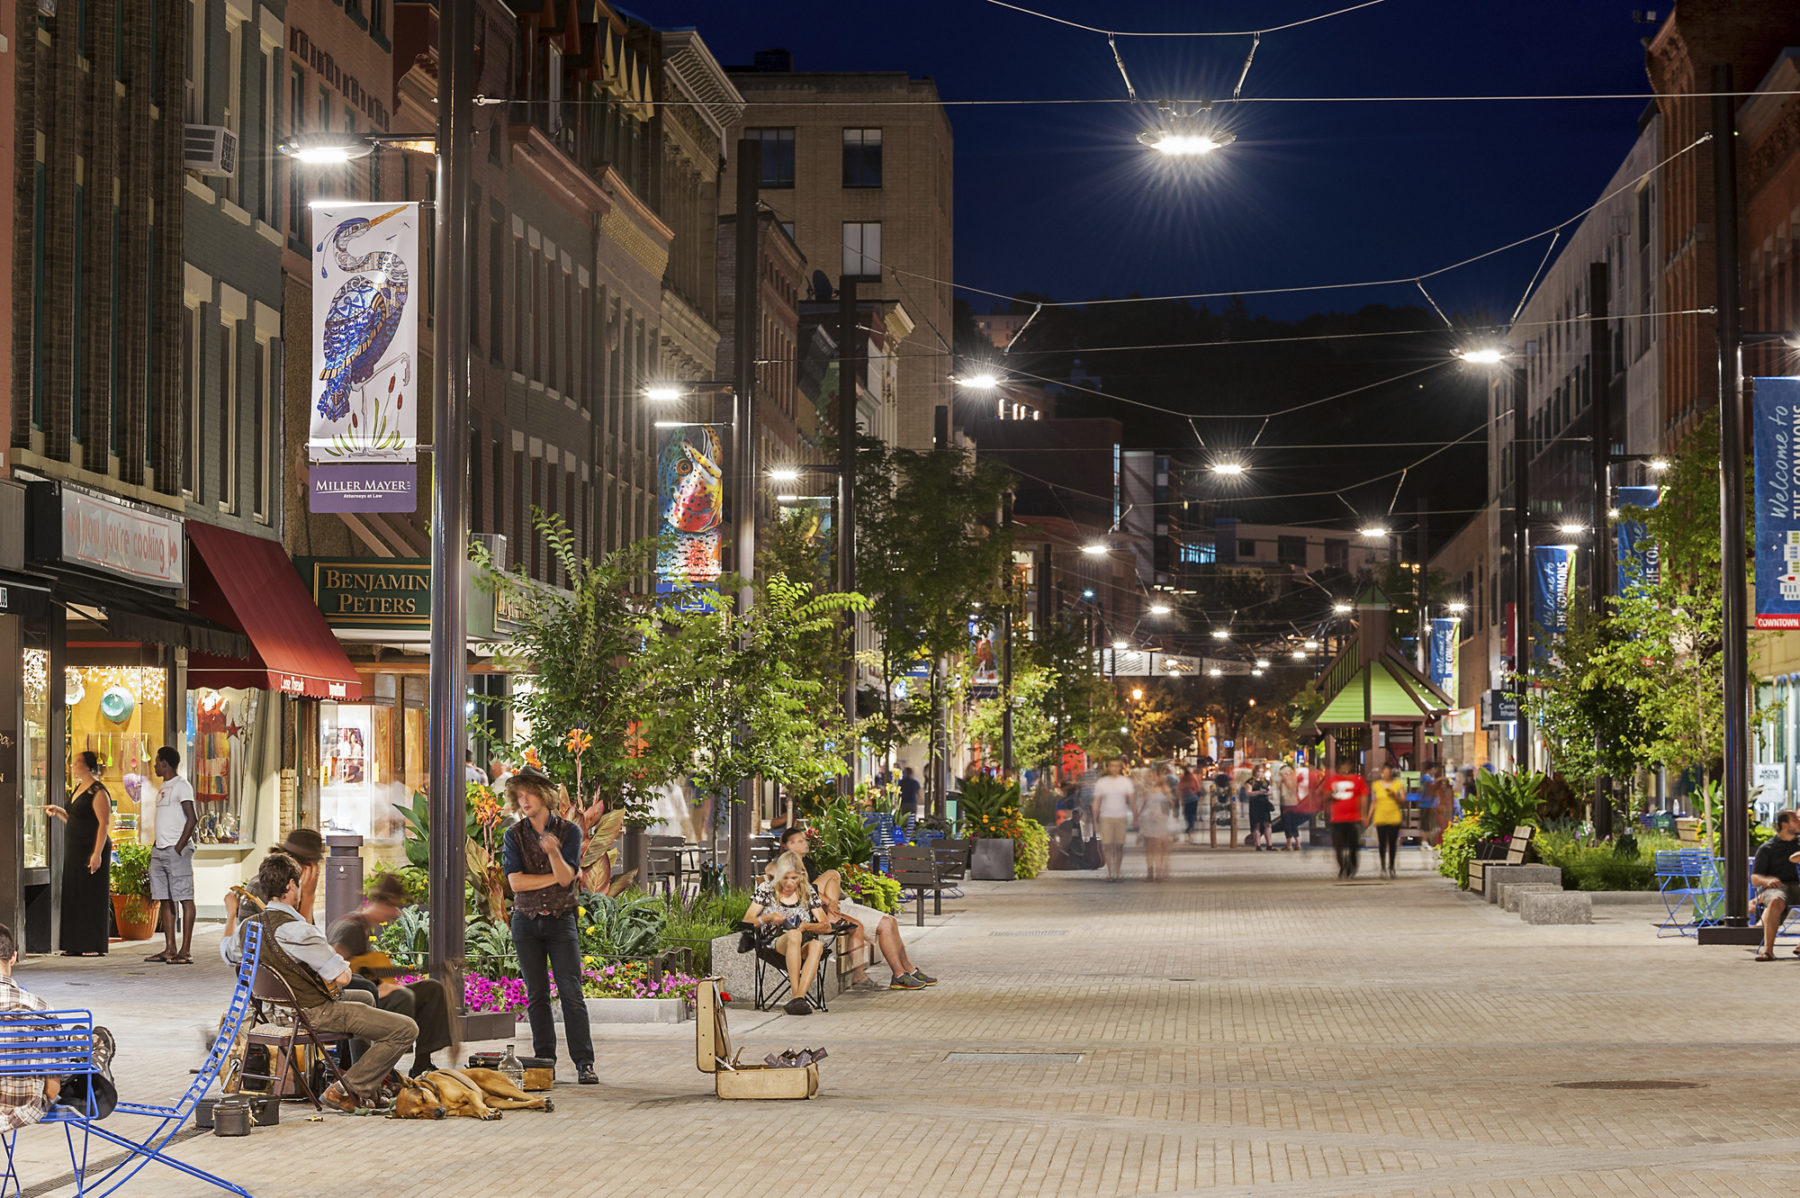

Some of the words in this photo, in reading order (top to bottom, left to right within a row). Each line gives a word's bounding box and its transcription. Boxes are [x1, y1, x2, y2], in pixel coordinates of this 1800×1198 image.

[1768, 406, 1789, 426] to
[316, 480, 361, 491] MILLER
[364, 480, 406, 490] MAYER
[1768, 432, 1790, 518] Welcome
[102, 521, 130, 560] you're
[132, 526, 165, 574] cooking
[326, 569, 430, 593] BENJAMIN
[338, 593, 416, 614] PETERS
[1543, 576, 1556, 626] Welcome
[1758, 618, 1798, 627] DOWNTOWN
